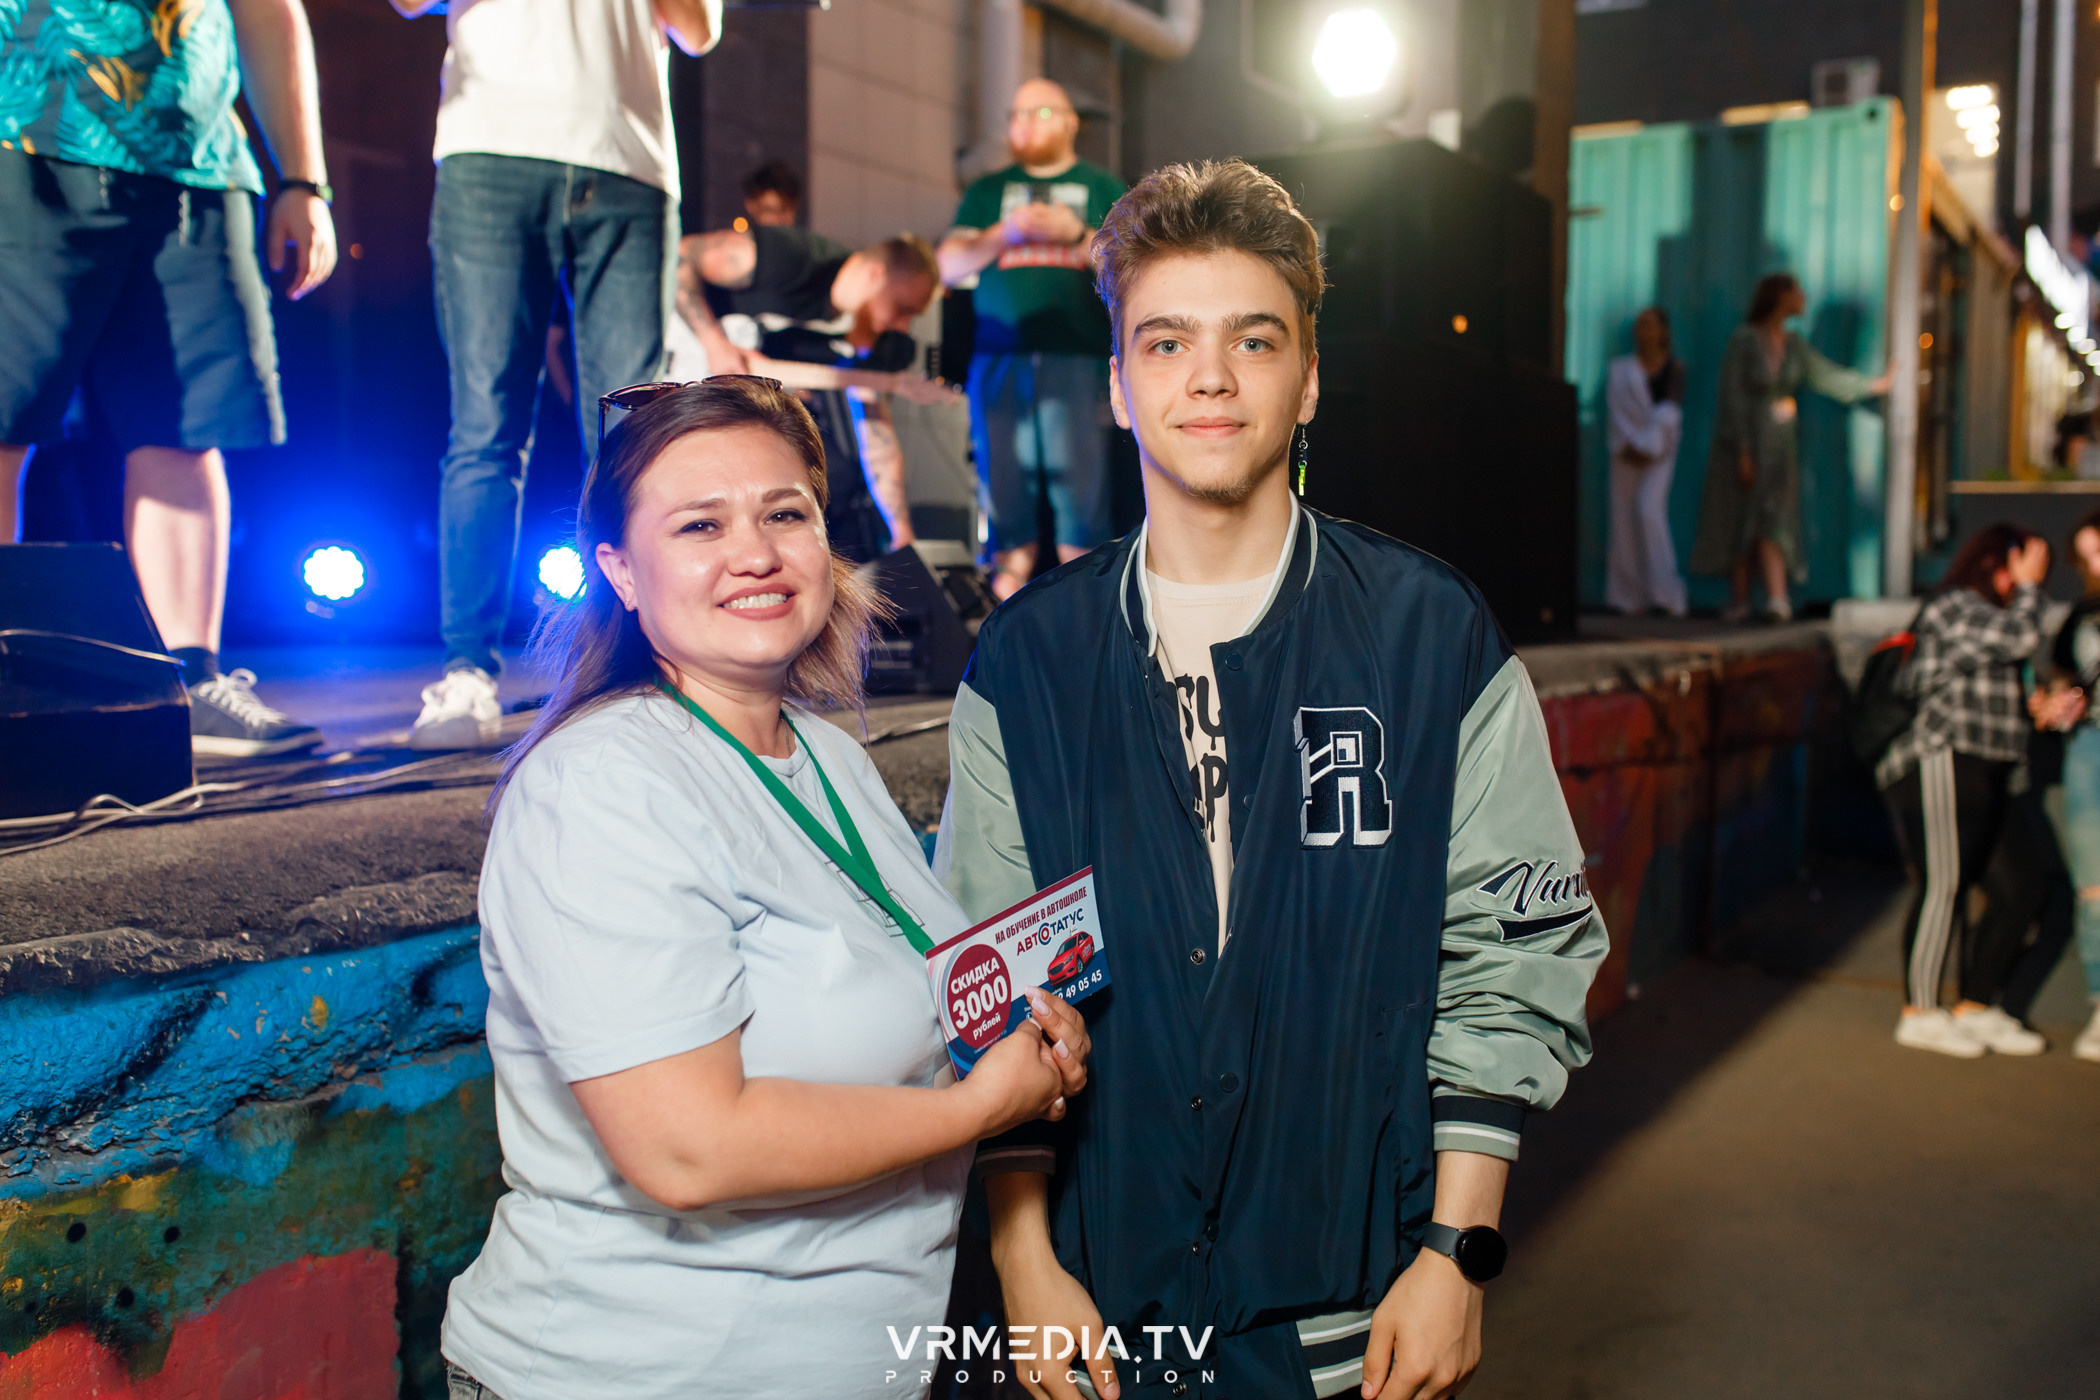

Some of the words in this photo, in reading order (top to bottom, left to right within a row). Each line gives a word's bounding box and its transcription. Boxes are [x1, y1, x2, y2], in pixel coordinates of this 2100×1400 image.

[1293, 706, 1393, 850] R
[995, 931, 1006, 945] НА
[1005, 911, 1040, 938] ОБУЧЕНИЕ
[1040, 908, 1046, 920] В
[1046, 886, 1087, 917] АВТОШКОЛЕ
[950, 957, 1000, 995] СКИДКА
[1065, 984, 1076, 999] 49
[1078, 977, 1089, 992] 05
[1091, 969, 1102, 983] 45
[952, 974, 1008, 1030] 3000
[972, 1011, 1001, 1041] рублей
